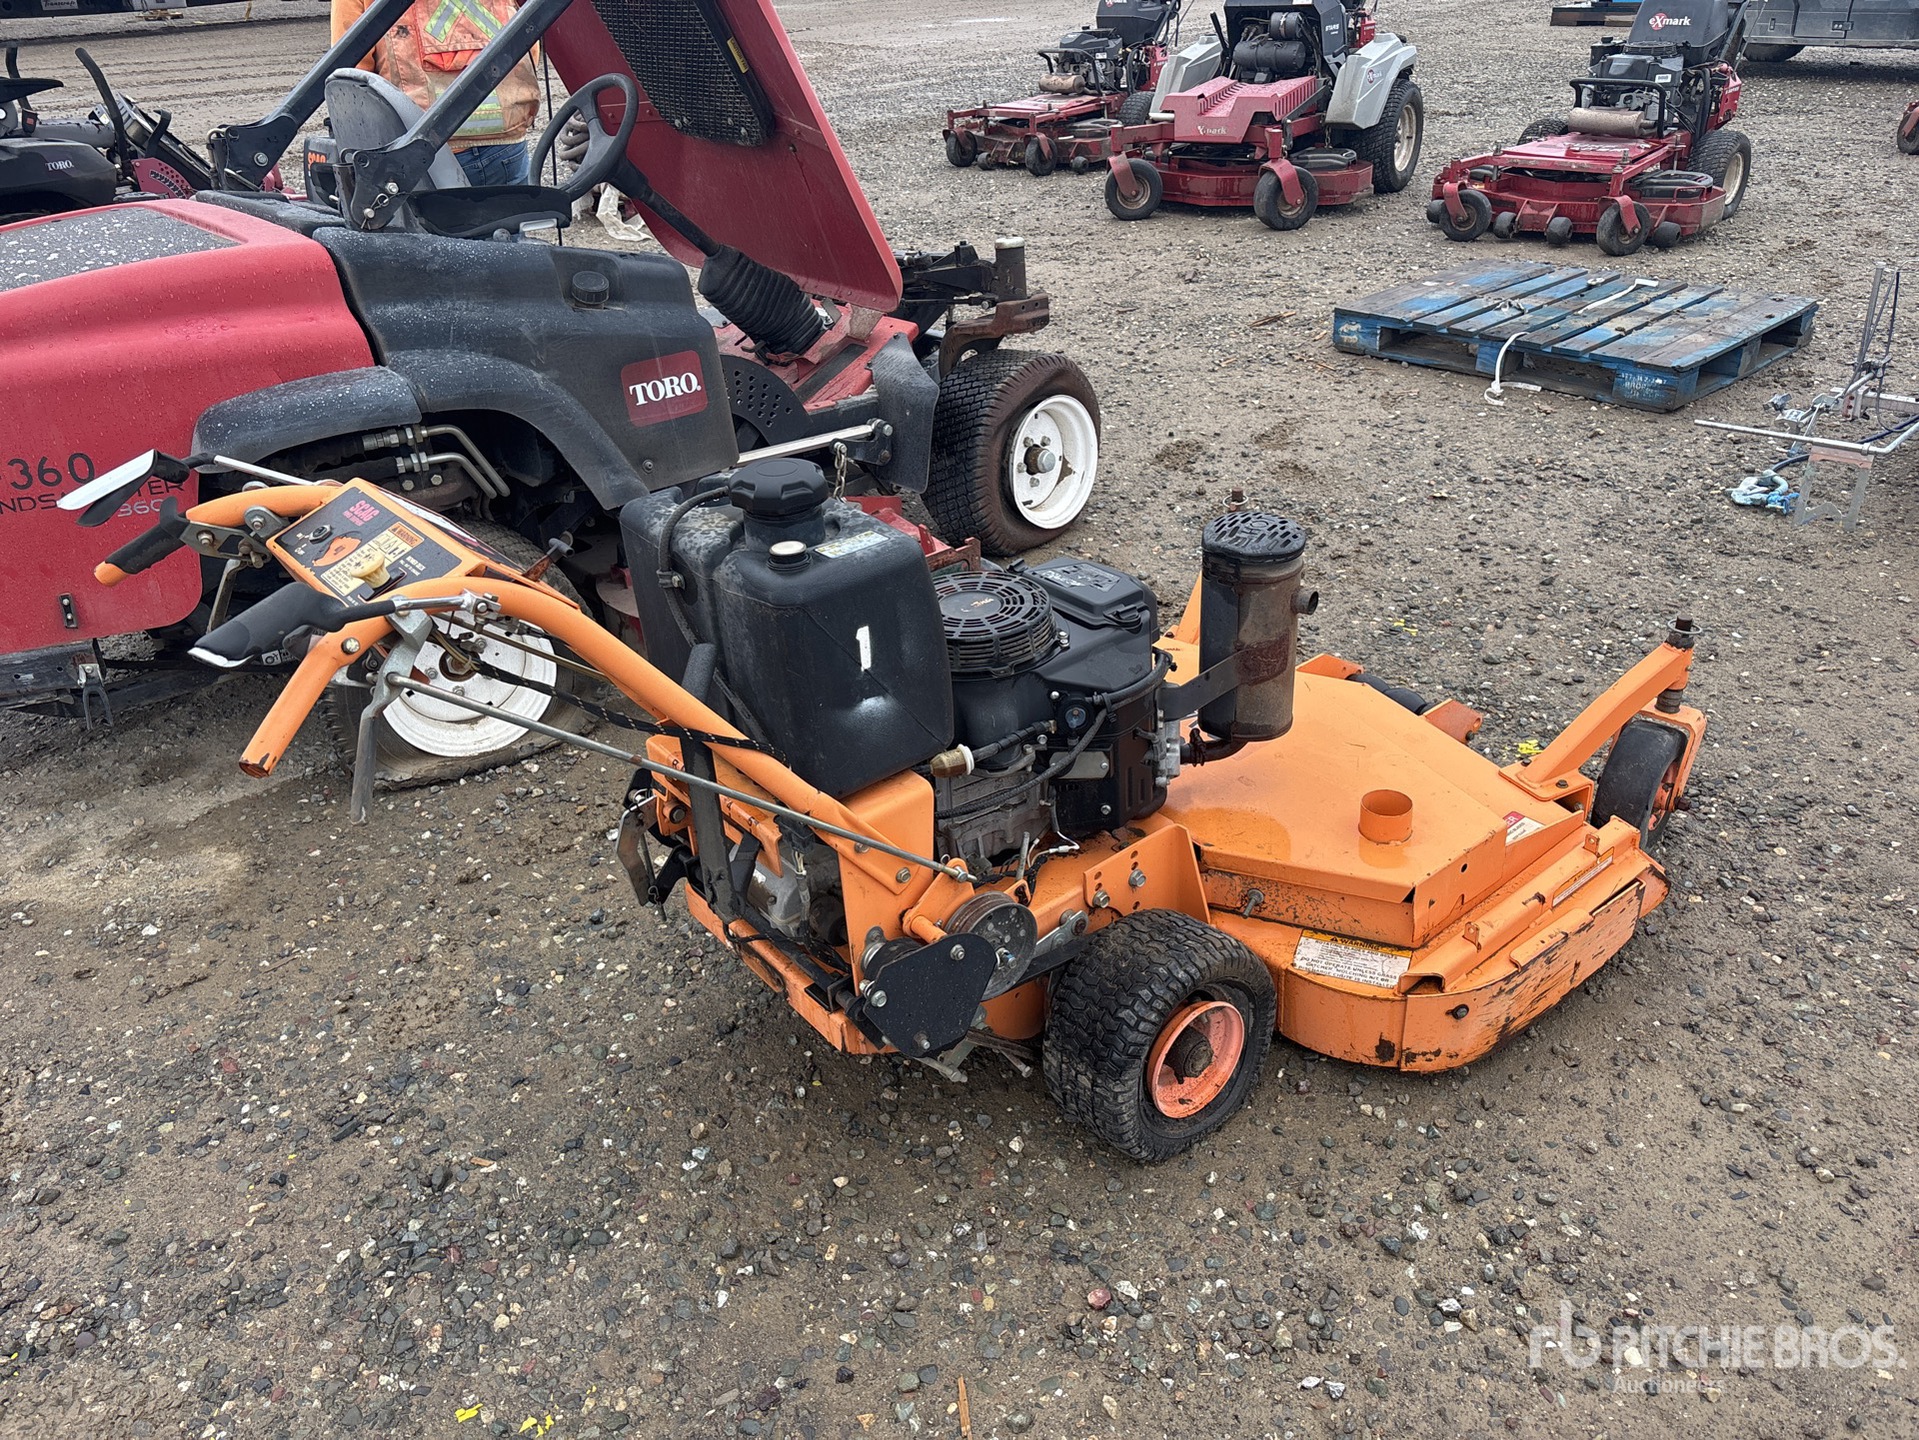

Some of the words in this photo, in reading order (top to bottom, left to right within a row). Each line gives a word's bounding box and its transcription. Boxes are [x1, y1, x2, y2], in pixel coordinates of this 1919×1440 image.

[1340, 938, 1380, 951] WARNING
[1324, 961, 1351, 970] OPERATE
[1352, 967, 1376, 975] UNLESS
